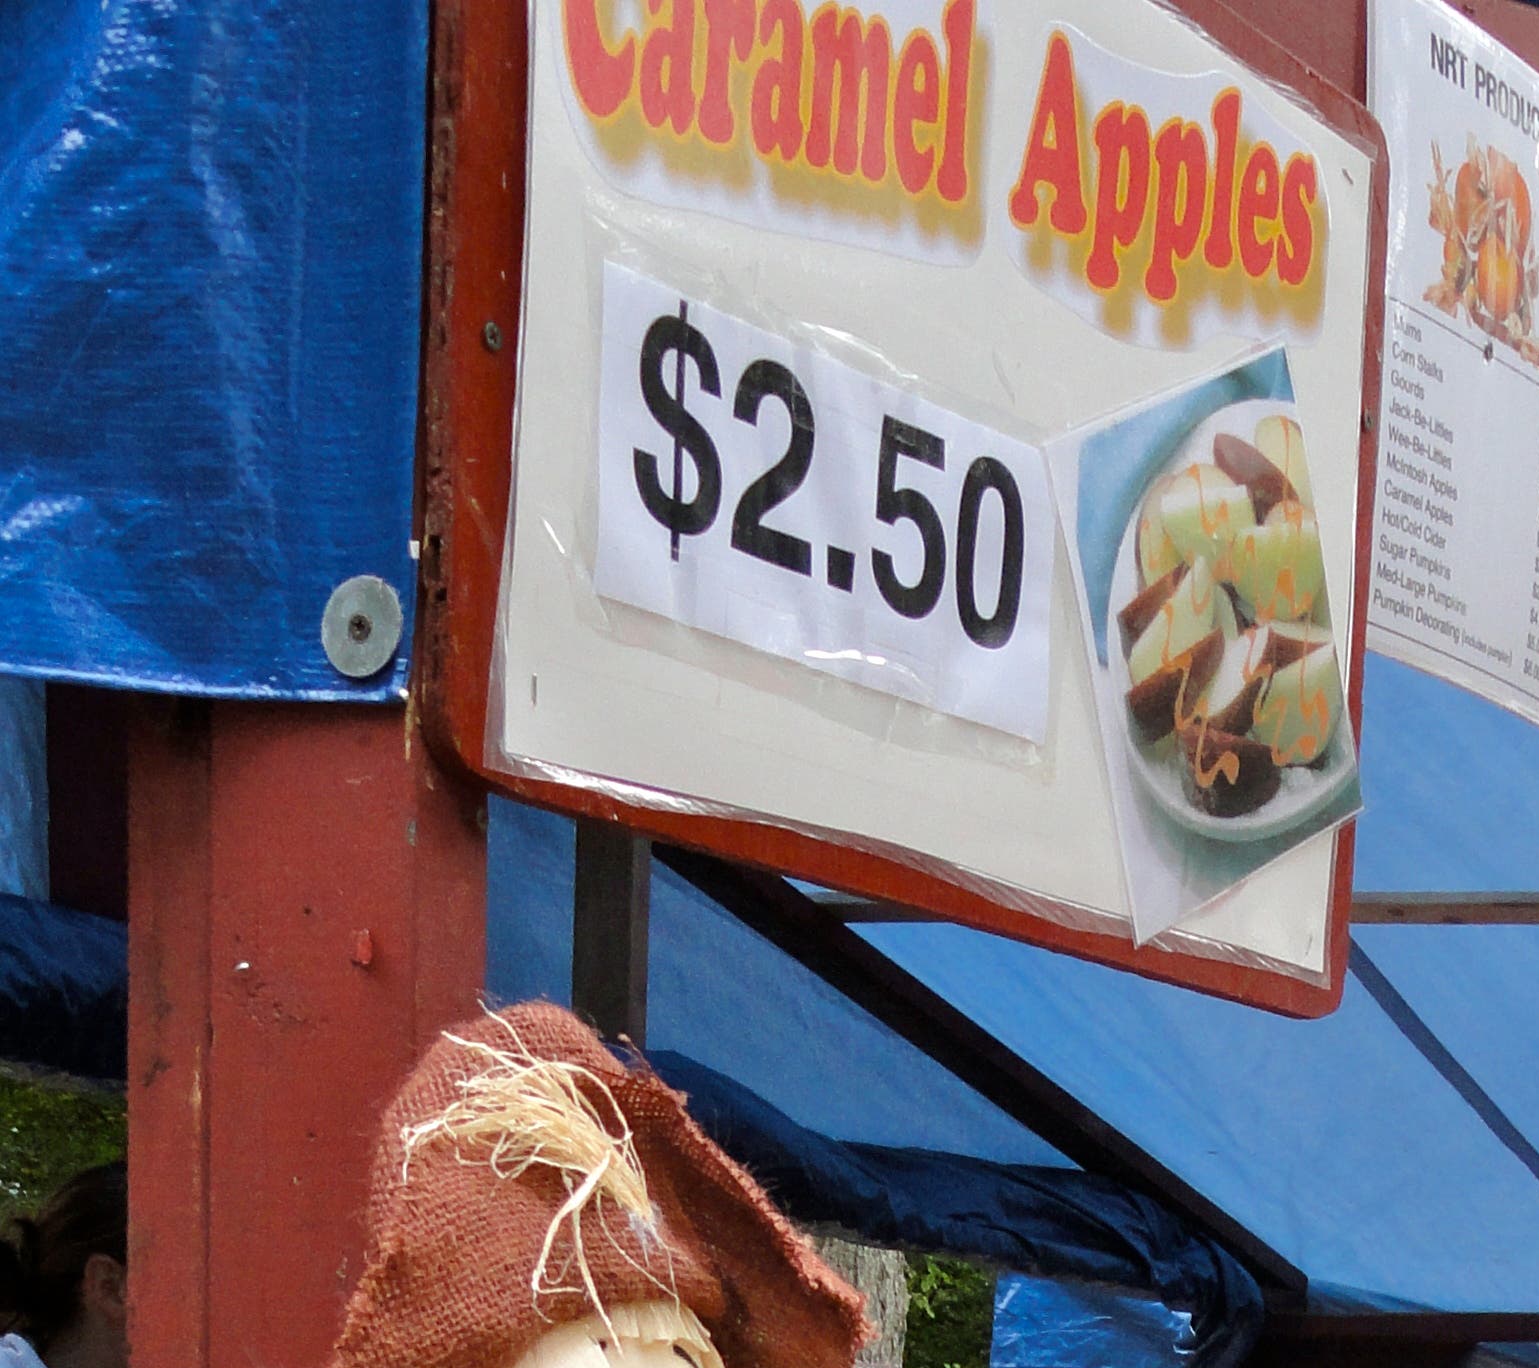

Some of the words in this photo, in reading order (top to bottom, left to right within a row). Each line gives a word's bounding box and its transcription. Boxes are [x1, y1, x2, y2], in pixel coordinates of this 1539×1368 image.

[1430, 32, 1468, 90] NRT
[560, 0, 978, 203] Caramel
[1009, 27, 1319, 303] Apples
[1390, 369, 1425, 401] Gourds
[632, 300, 1025, 649] $2.50
[1429, 473, 1458, 503] Apples
[1384, 478, 1424, 512] Caramel
[1424, 498, 1455, 528] Apples
[1379, 533, 1408, 561] Sugar
[1409, 547, 1452, 581] Pumpkins
[1423, 525, 1447, 550] Cider
[1376, 561, 1426, 599] Med-Large
[1373, 588, 1414, 620] Pumpkin
[1415, 606, 1460, 645] Decorating
